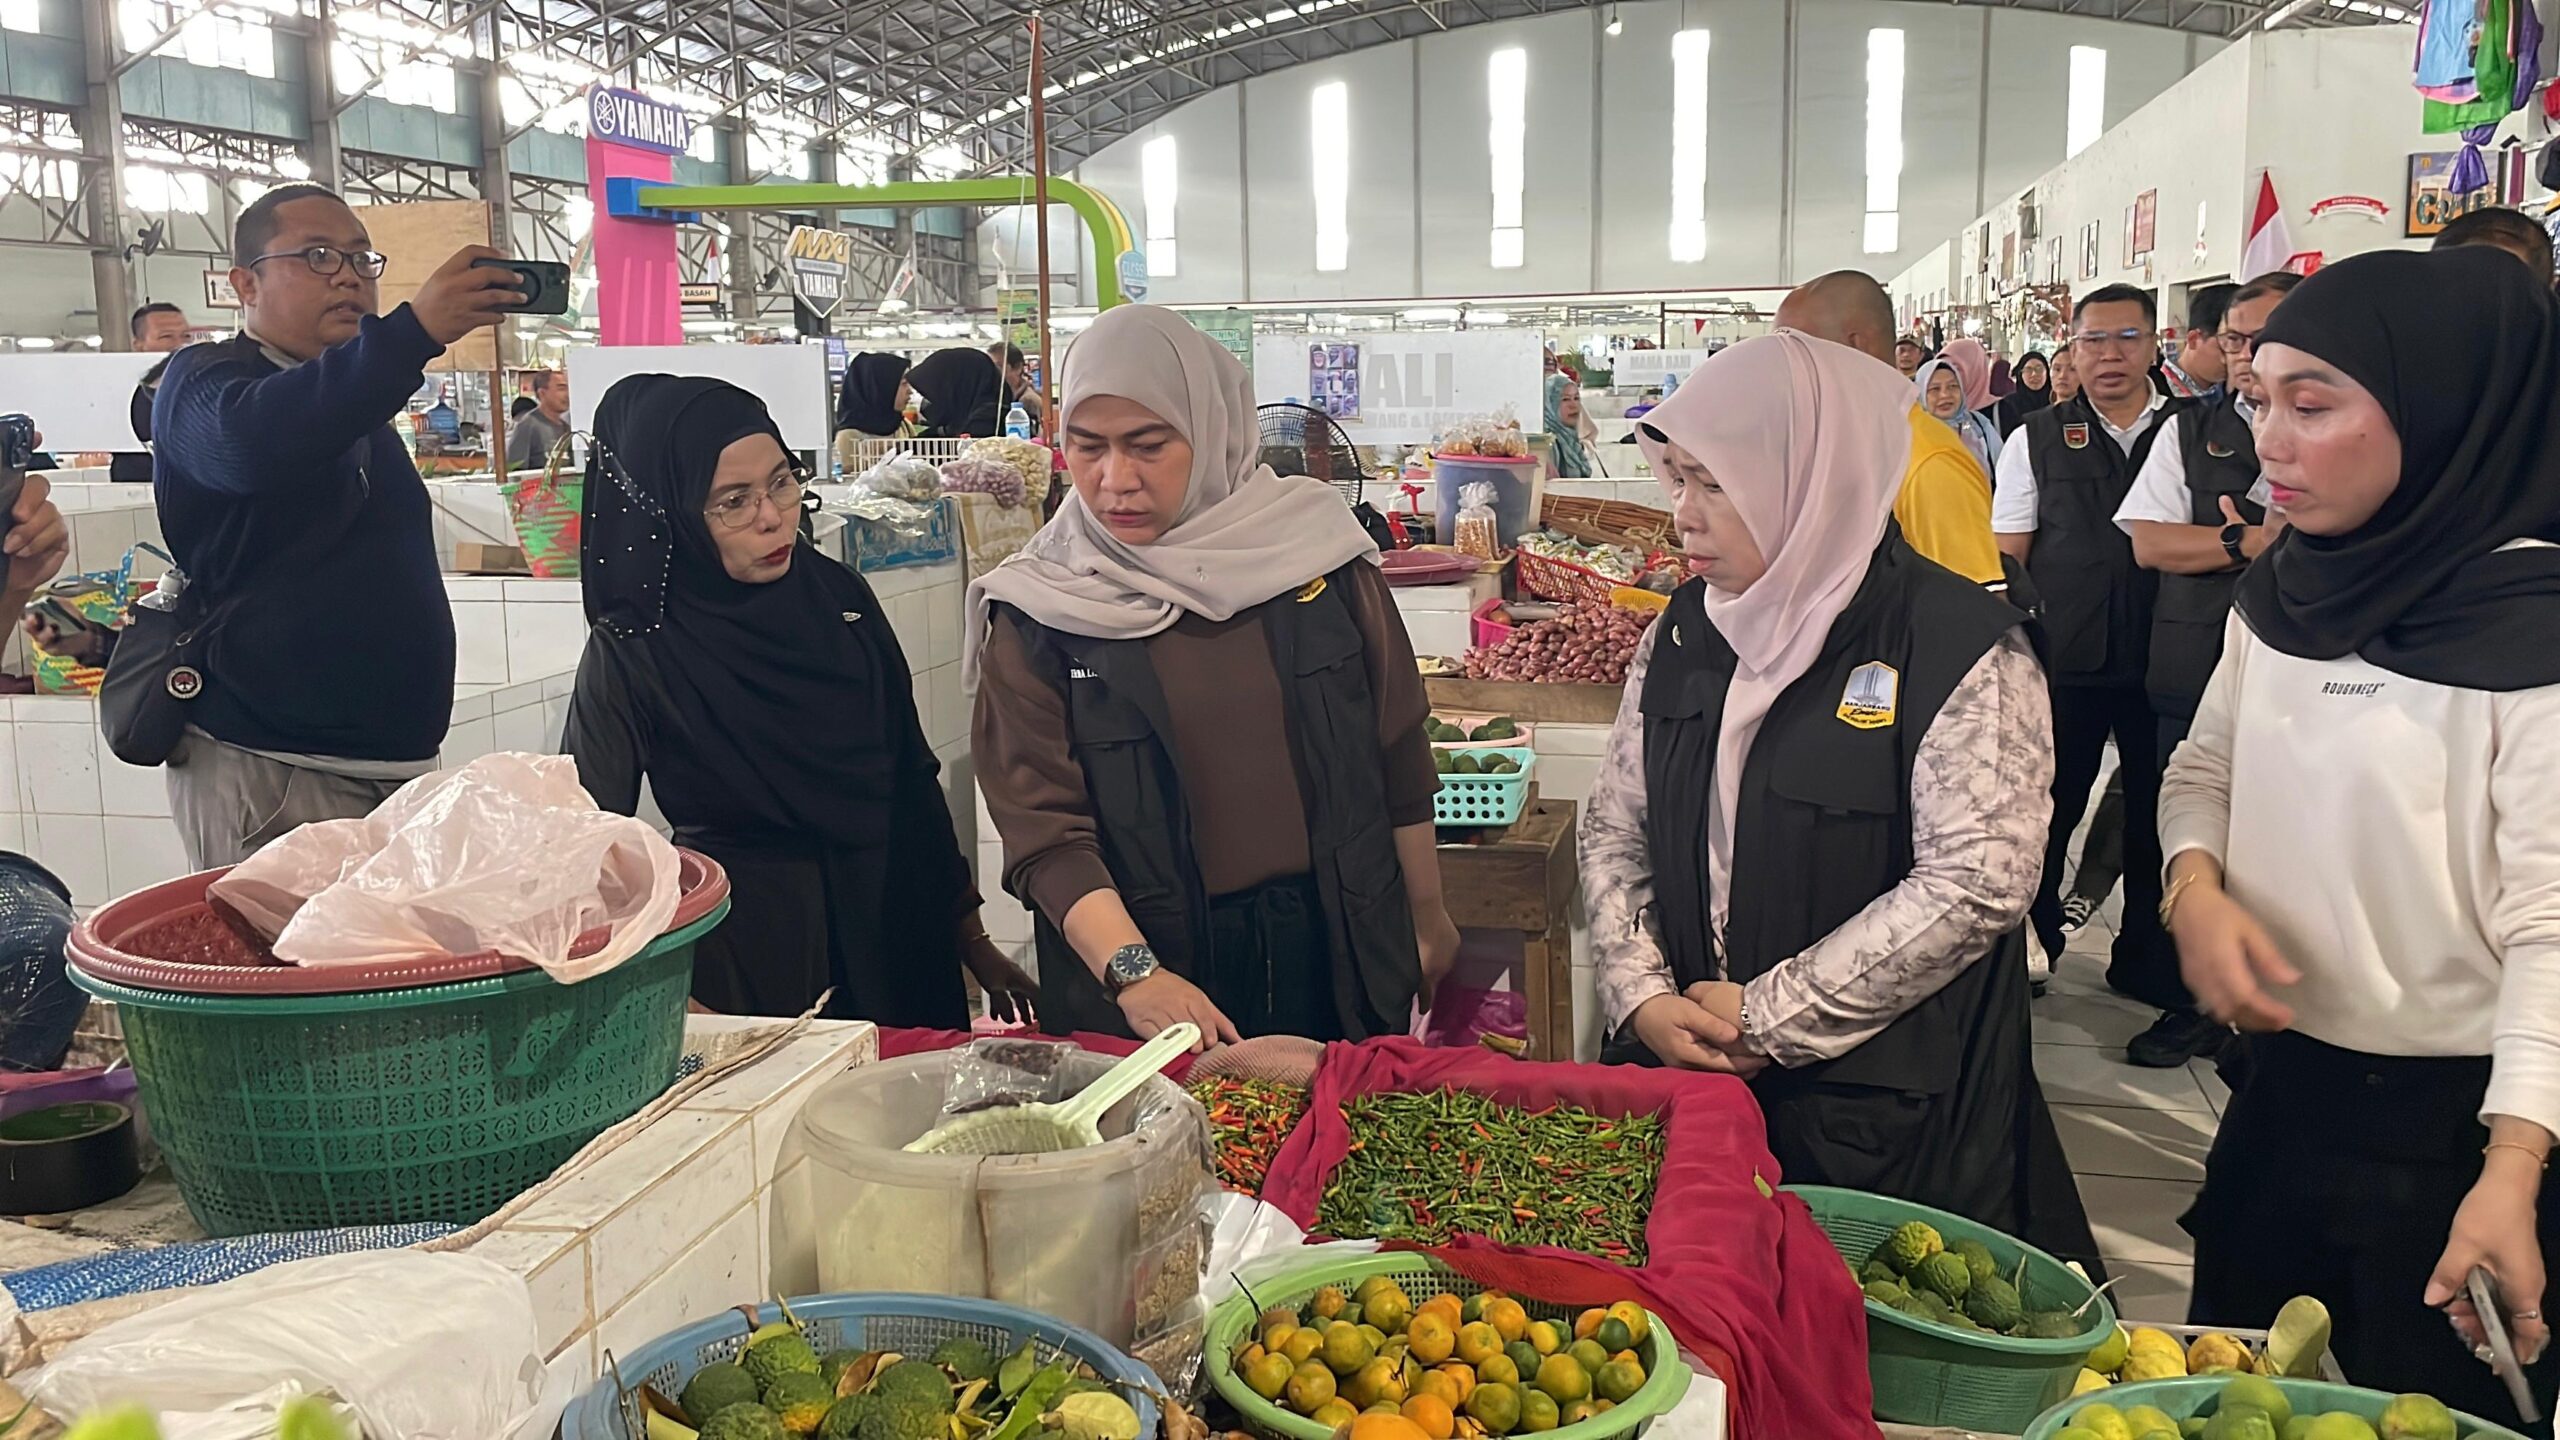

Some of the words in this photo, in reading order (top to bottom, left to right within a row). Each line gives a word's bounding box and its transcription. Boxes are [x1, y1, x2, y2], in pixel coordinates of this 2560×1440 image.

[613, 96, 688, 149] YAMAHA
[684, 289, 711, 297] BASAH
[802, 273, 839, 299] YAMAHA
[1363, 353, 1453, 408] ALI
[2321, 681, 2382, 695] ROUGHNECK
